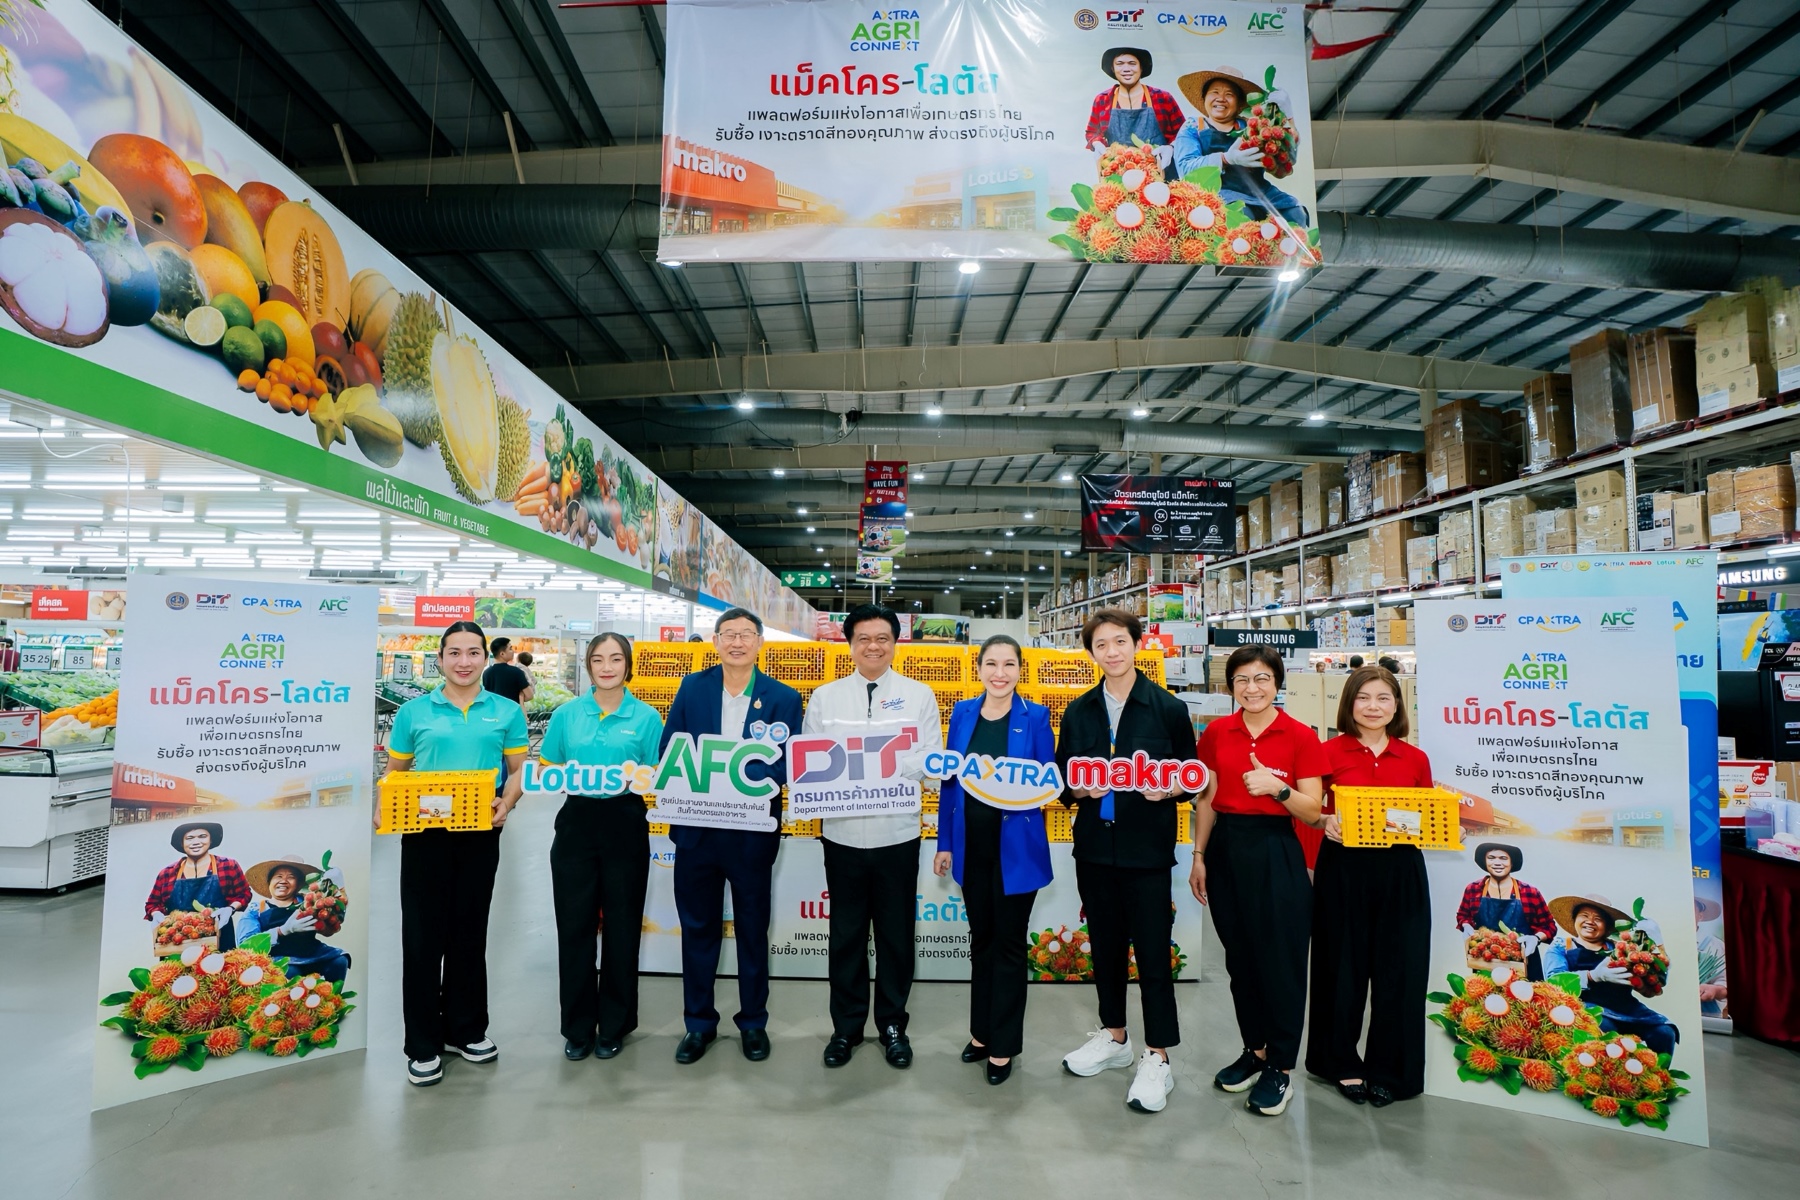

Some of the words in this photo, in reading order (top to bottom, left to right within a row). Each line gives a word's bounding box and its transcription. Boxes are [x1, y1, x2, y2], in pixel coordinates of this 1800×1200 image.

[872, 9, 920, 20] AXTRA
[1158, 13, 1176, 24] CP
[1247, 12, 1285, 30] AFC
[850, 21, 920, 41] AGRI
[850, 41, 920, 52] CONNEXT
[769, 62, 999, 97] แม็คโคร-โลตัส
[748, 103, 1022, 122] แพลตฟอร์มแห่งโอกาสเพื่อเกษตรกรไทย
[715, 122, 754, 142] รับซื้อ
[758, 127, 925, 143] เงาะตราดสีทองคุณภาพ
[929, 126, 1055, 144] ส่งตรงถึงผู้บริโภค
[673, 148, 747, 182] makro
[968, 164, 1035, 187] Lotus's
[433, 508, 452, 523] FRUIT
[460, 517, 489, 536] VEGETABLE
[1685, 557, 1704, 565] AFC
[1718, 566, 1787, 585] AMSUNG
[242, 597, 258, 606] CP
[318, 598, 349, 612] AFC
[1518, 615, 1534, 625] CP
[1600, 612, 1635, 626] AFC
[241, 633, 285, 643] AXTRA
[1237, 632, 1296, 645] SAMSUNG
[220, 643, 285, 659] AGRI
[1522, 653, 1567, 662] AXTRA
[219, 659, 284, 669] CONNEXT
[1503, 663, 1568, 680] AGRI
[149, 677, 351, 705] แม็คโคร-โลตัส
[1503, 680, 1568, 690] CONNEXT
[186, 711, 323, 726] แพลตฟอร์มแห่งโอกาส
[1443, 697, 1650, 730] แม็คโคร-โลตัส
[199, 727, 303, 742] เพื่อเกษตรกรไทย
[156, 744, 194, 759] รับซื้อ
[198, 743, 341, 758] เงาะตราดสีทองคุณภาพ
[1477, 735, 1619, 751] แพลตฟอร์มแห่งโอกาส
[195, 759, 307, 774] ส่งตรงถึงผู้บริโภค
[1491, 750, 1598, 767] เพื่อเกษตรกรไทย
[655, 737, 777, 798] AFC
[925, 752, 960, 776] CP
[961, 757, 1060, 790] AXTRA
[1069, 752, 1208, 790] makro
[1455, 763, 1489, 778] รับซื้อ
[1492, 769, 1644, 786] เงาะตราดสีทองคุณภาพ
[123, 769, 176, 790] makro
[524, 760, 652, 792] Lotus's
[793, 784, 916, 804] กรมการค้าภายใน
[1490, 785, 1605, 801] ส่งตรงถึงผู้บริโภค
[793, 804, 845, 816] Department
[846, 803, 855, 811] of
[856, 802, 889, 811] Internal
[891, 800, 916, 809] Trade
[770, 942, 798, 956] รับซื้อ
